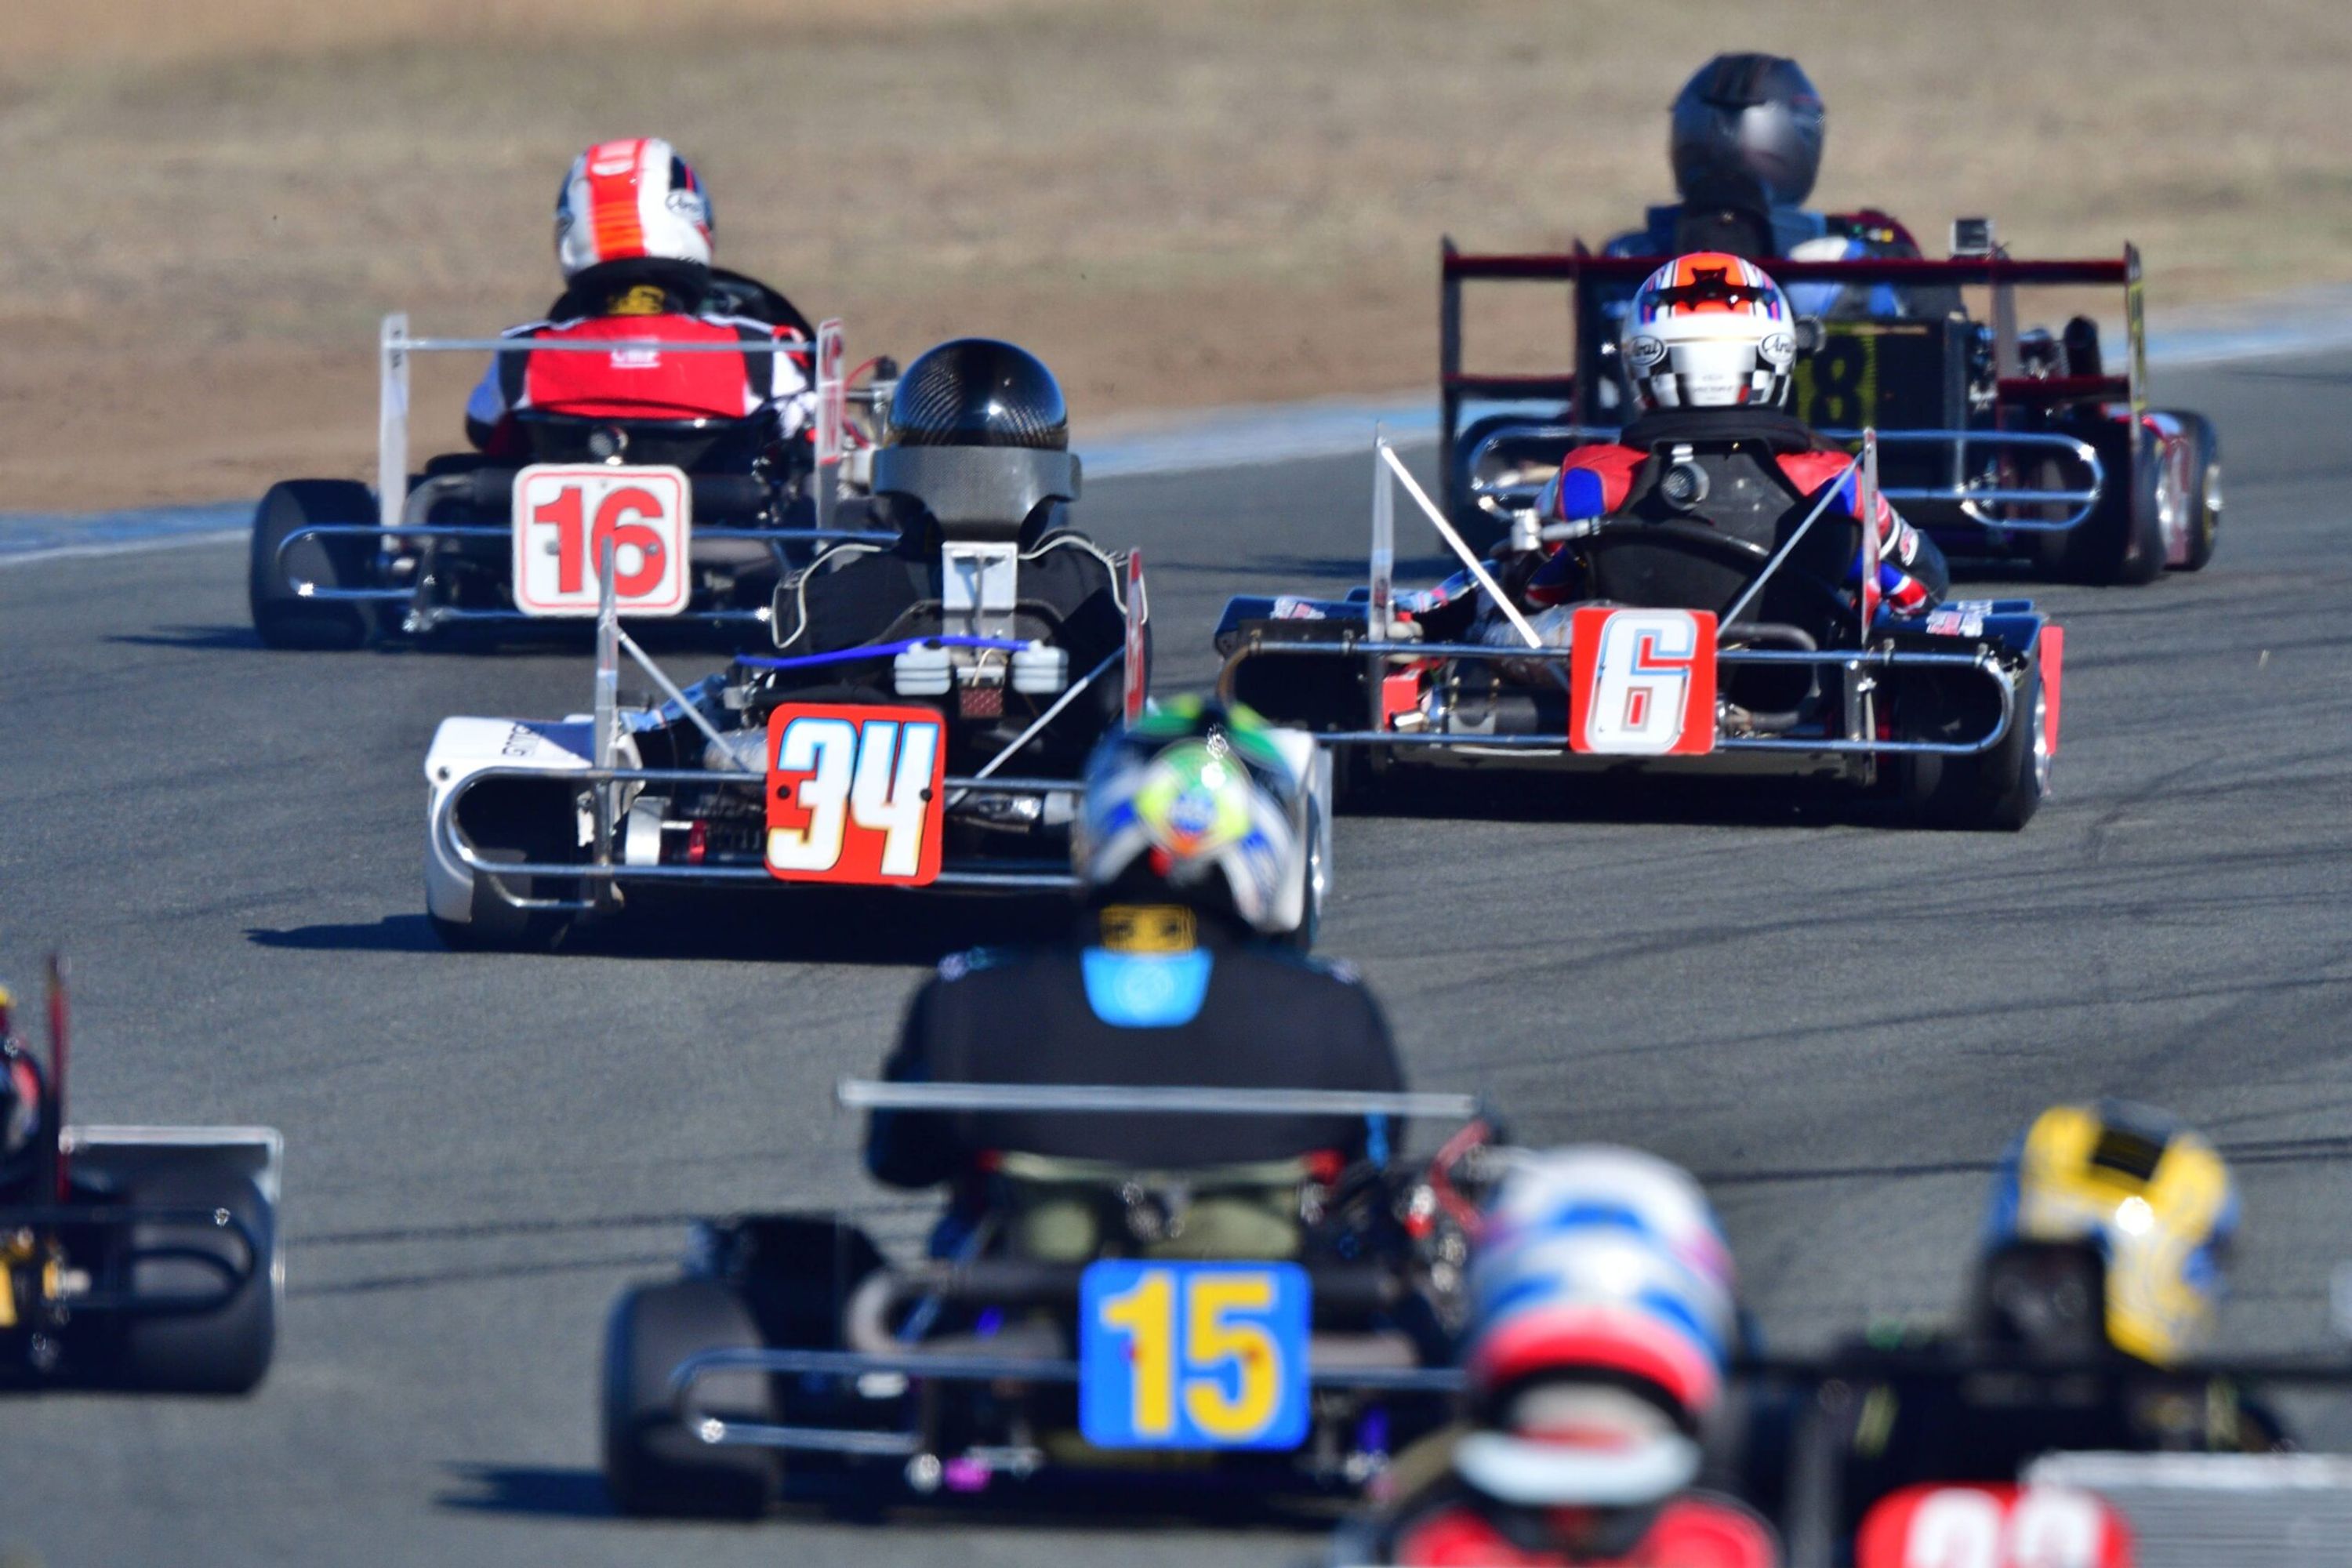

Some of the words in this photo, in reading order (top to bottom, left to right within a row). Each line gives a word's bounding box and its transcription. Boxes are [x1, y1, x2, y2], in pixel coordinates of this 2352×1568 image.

[1794, 335, 1864, 431] 8
[534, 485, 667, 598] 16
[1585, 612, 1697, 753] 6
[767, 717, 940, 877] 34
[1102, 1273, 1280, 1438] 15
